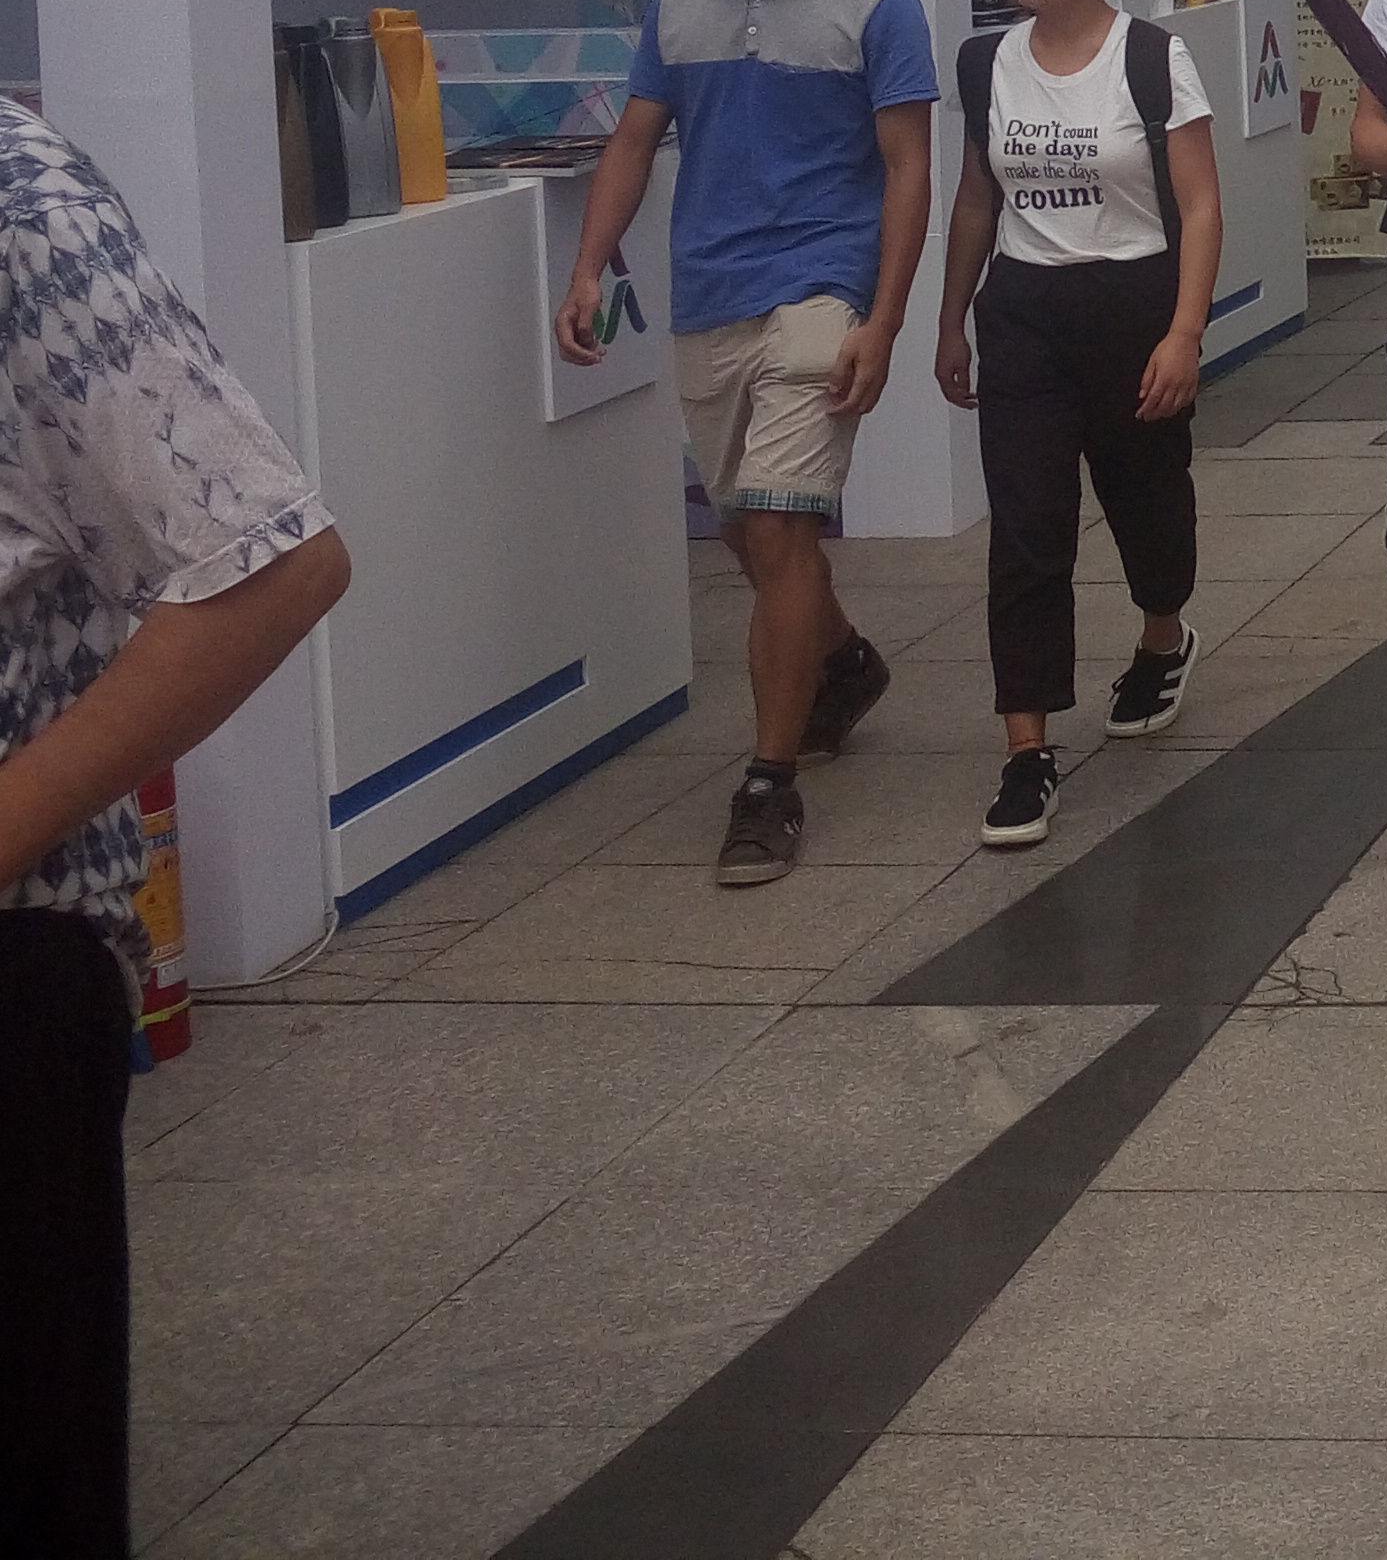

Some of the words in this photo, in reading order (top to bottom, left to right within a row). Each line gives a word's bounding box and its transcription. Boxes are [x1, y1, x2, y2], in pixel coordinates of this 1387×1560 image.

[1006, 119, 1062, 138] Don't
[1063, 126, 1099, 139] count
[1003, 138, 1037, 156] the
[1045, 139, 1099, 160] days
[1004, 161, 1040, 179] make
[1043, 161, 1065, 179] the
[1068, 163, 1100, 183] days
[1014, 184, 1104, 210] count
